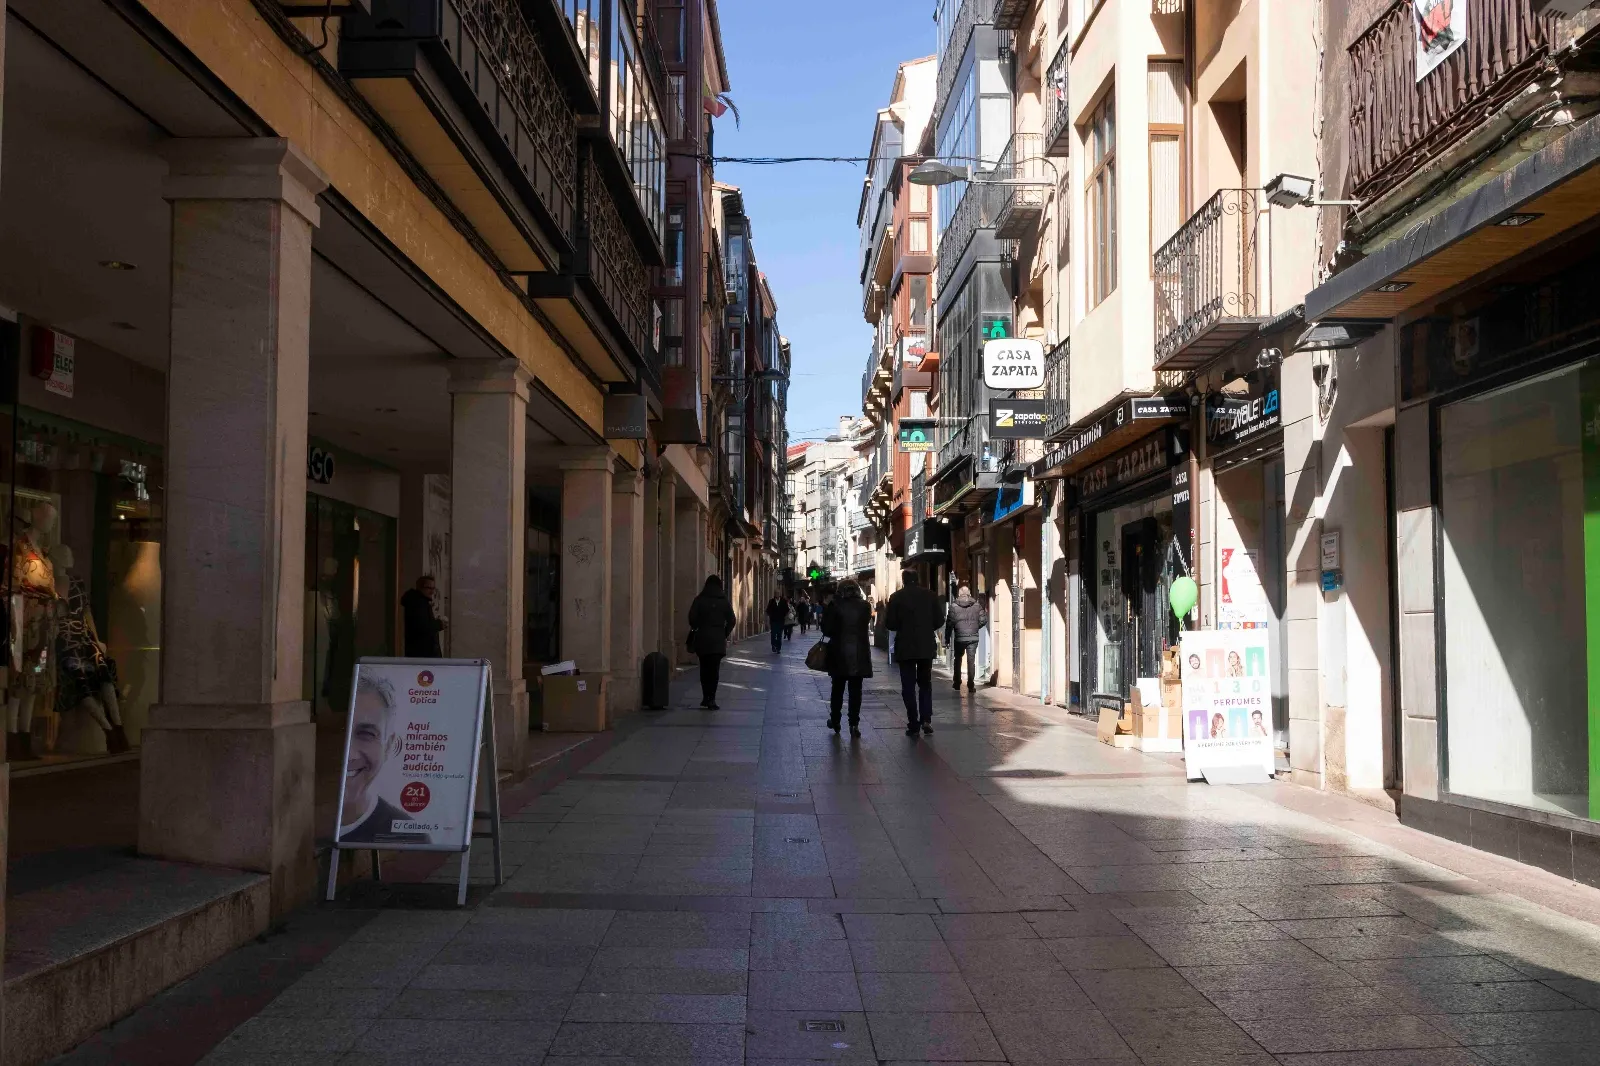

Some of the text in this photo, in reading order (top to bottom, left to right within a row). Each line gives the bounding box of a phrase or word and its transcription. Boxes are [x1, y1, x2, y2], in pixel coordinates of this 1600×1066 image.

[997, 350, 1032, 361] CASA
[991, 365, 1038, 376] ZAPATA
[1137, 405, 1187, 414] CASA ZAPATA
[1082, 440, 1161, 496] CASA ZAPATA
[1175, 471, 1188, 486] CASA
[408, 688, 440, 696] General
[1213, 697, 1262, 706] PERFUMES
[407, 722, 430, 733] Aquí
[406, 733, 448, 741] miramos
[405, 742, 446, 751] también
[403, 753, 434, 762] por tu
[402, 763, 444, 772] audición
[406, 787, 425, 797] 2x1
[403, 822, 433, 831] Collado,
